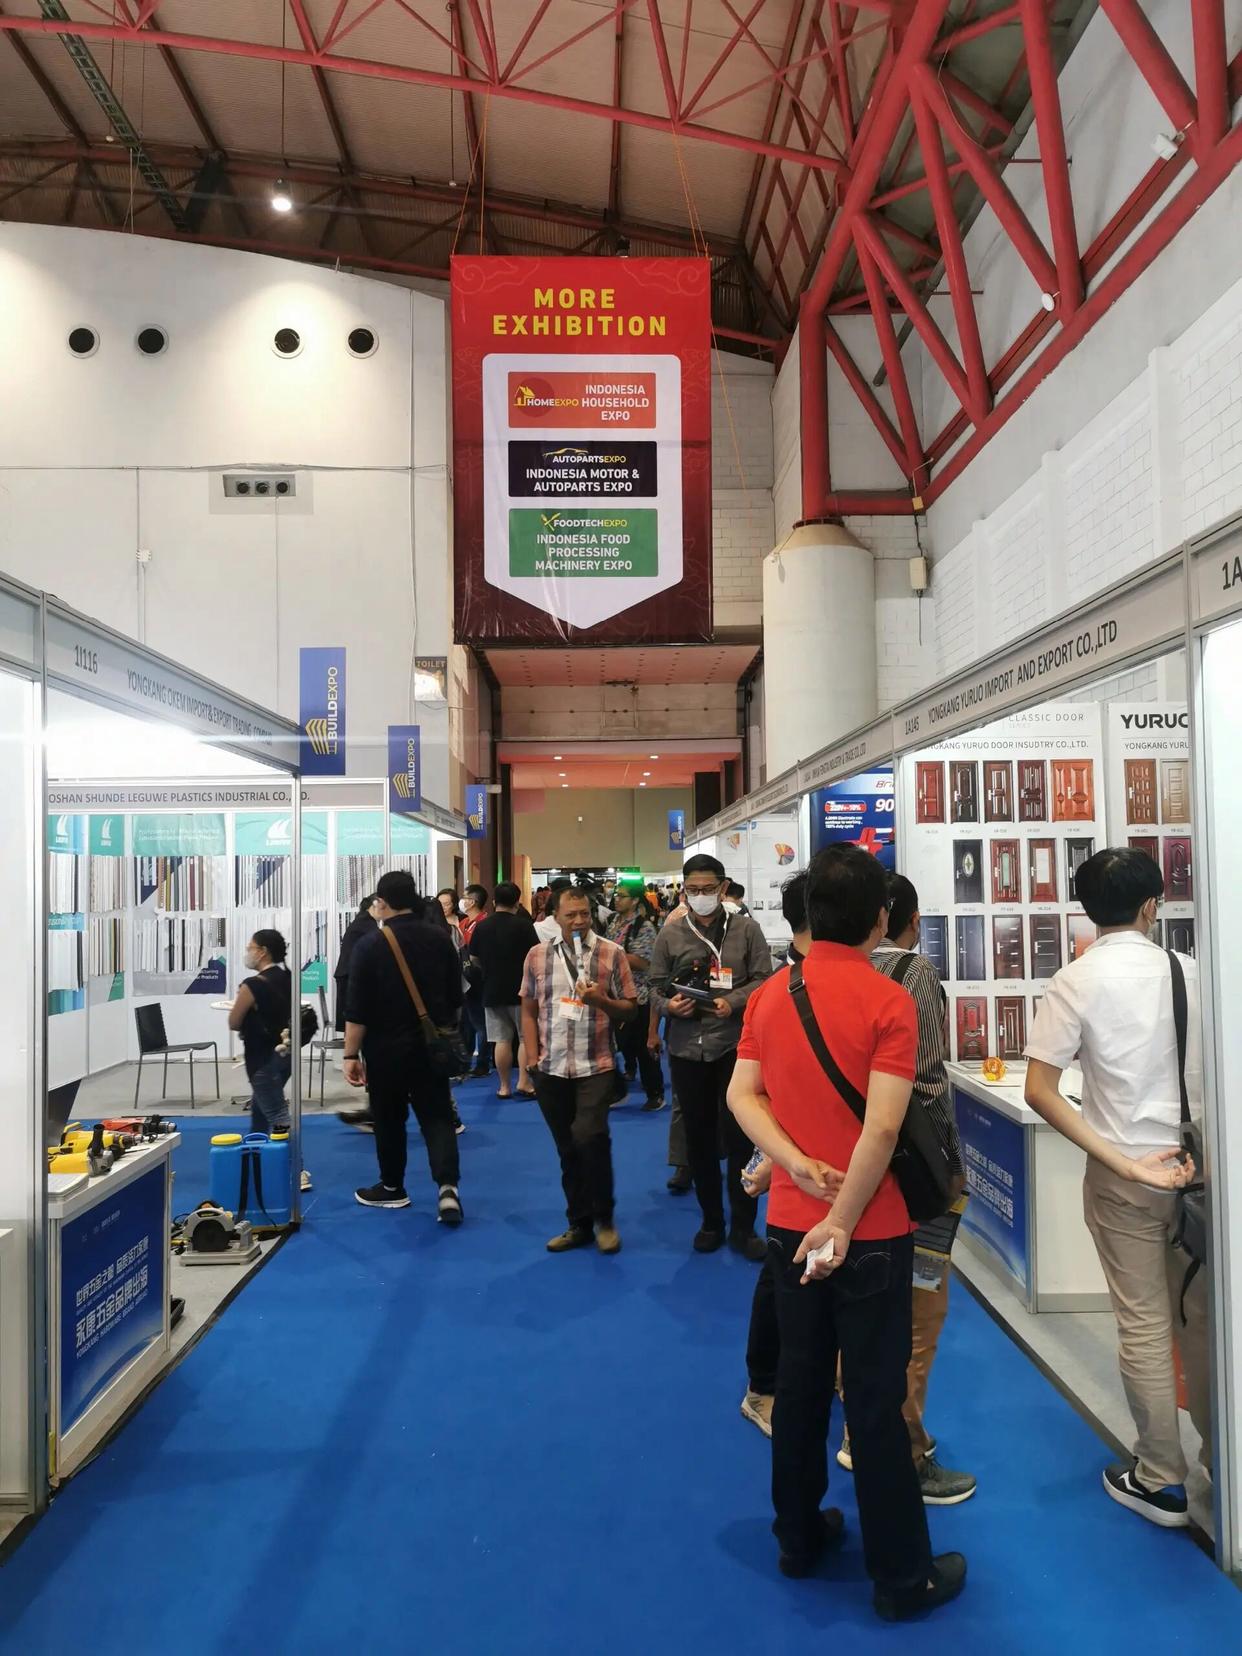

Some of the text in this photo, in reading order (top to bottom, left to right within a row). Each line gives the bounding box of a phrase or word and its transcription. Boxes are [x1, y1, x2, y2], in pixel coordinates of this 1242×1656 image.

[534, 288, 615, 309] MORE
[492, 315, 666, 336] EXHIBITION
[585, 384, 645, 395] INDONESIA
[527, 398, 579, 407] HOMEEXPO
[581, 398, 649, 408] HOUSEHOLD
[601, 411, 630, 421] EXPO
[552, 455, 626, 463] AUTOPARTSEXPO
[526, 469, 640, 479] INDONESIA MOTOR &
[533, 482, 632, 492] AUTOPARTS EXPO
[553, 519, 627, 527] FOODTECHEXPO
[537, 534, 630, 544] INDONESIA FOOD
[549, 547, 619, 557] PROCESSING
[535, 560, 632, 570] MACHINERY EXPO
[416, 660, 446, 668] TOILET
[928, 695, 960, 725] YONGKANG
[960, 684, 984, 710] YURUO
[985, 669, 1014, 700] IMPORT
[1017, 659, 1036, 685] AND
[1037, 640, 1073, 676] EXPORT
[1076, 620, 1117, 657] CO.,LTD
[127, 669, 168, 705] YONGKANG
[327, 666, 338, 740] BUILDEXPO
[1008, 713, 1084, 722] CLASSIC DOOR
[962, 741, 989, 749] YURUO
[990, 741, 1013, 749] DOOR
[1015, 740, 1054, 749] INSUDTRY
[1124, 741, 1189, 750] YONGKANG YURU
[407, 737, 415, 788] BUILDEXPO
[48, 793, 83, 804] OSHAN
[85, 793, 125, 803] SHUNDE
[127, 792, 168, 803] LEGUWE
[170, 792, 213, 802] PLASTICS
[215, 791, 271, 802] INDUSTRIAL
